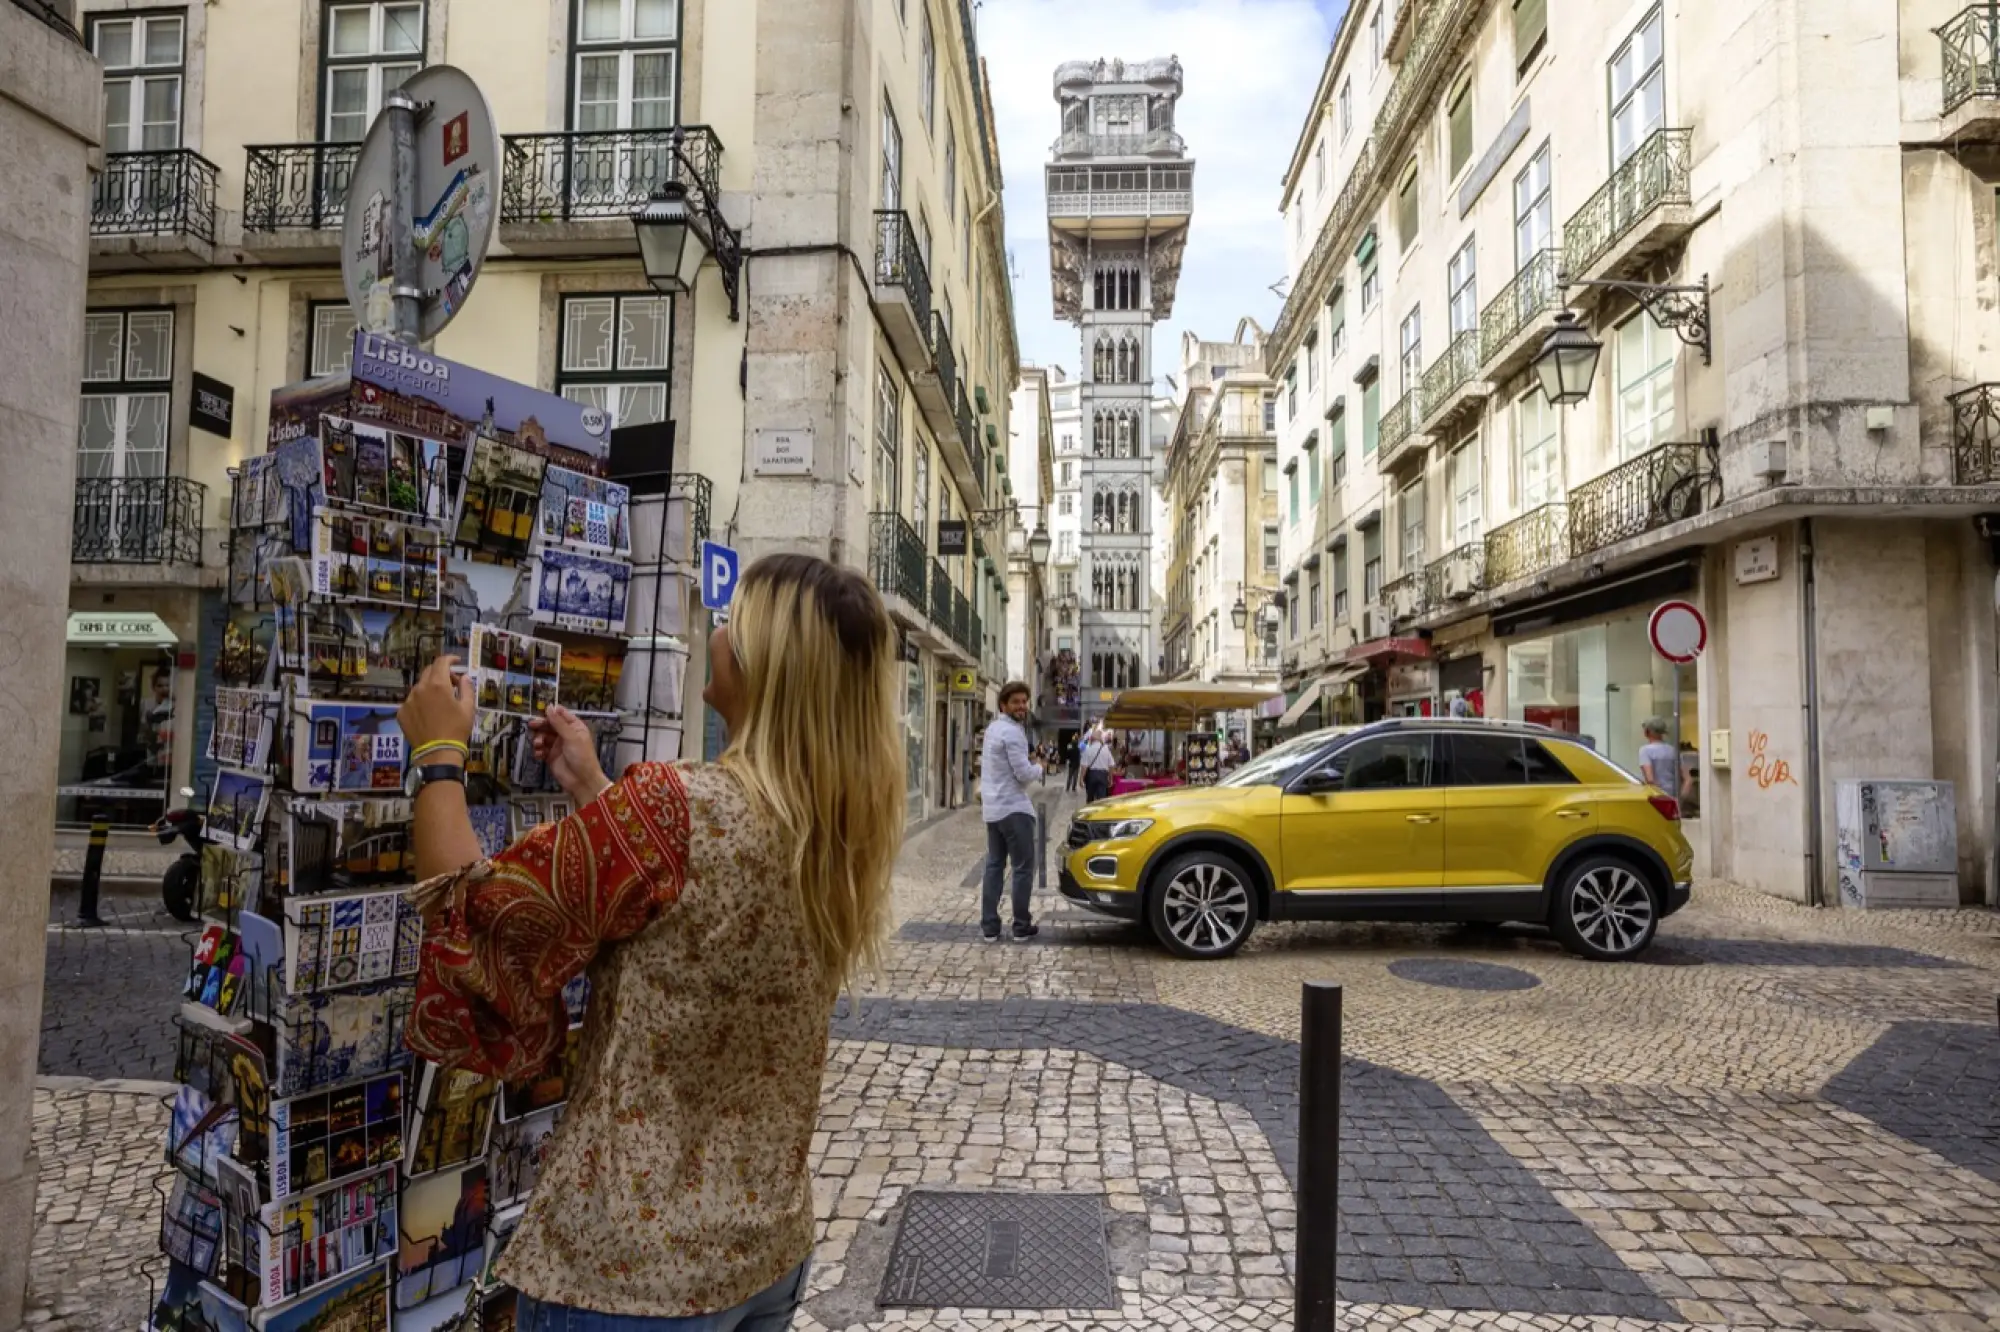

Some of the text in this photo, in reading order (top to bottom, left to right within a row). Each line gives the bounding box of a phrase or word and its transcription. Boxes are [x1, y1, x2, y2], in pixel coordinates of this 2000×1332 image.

[362, 333, 450, 380] Lisboa
[360, 358, 450, 397] postcards
[270, 420, 306, 442] Lisboa
[318, 560, 329, 593] LISBOA
[711, 553, 732, 599] P
[376, 749, 400, 759] BOA
[377, 736, 400, 748] LIS
[366, 924, 390, 936] POR
[371, 932, 384, 942] TU
[365, 939, 388, 950] GAL
[276, 1160, 287, 1199] LISBOA
[269, 1264, 281, 1303] LISBOA
